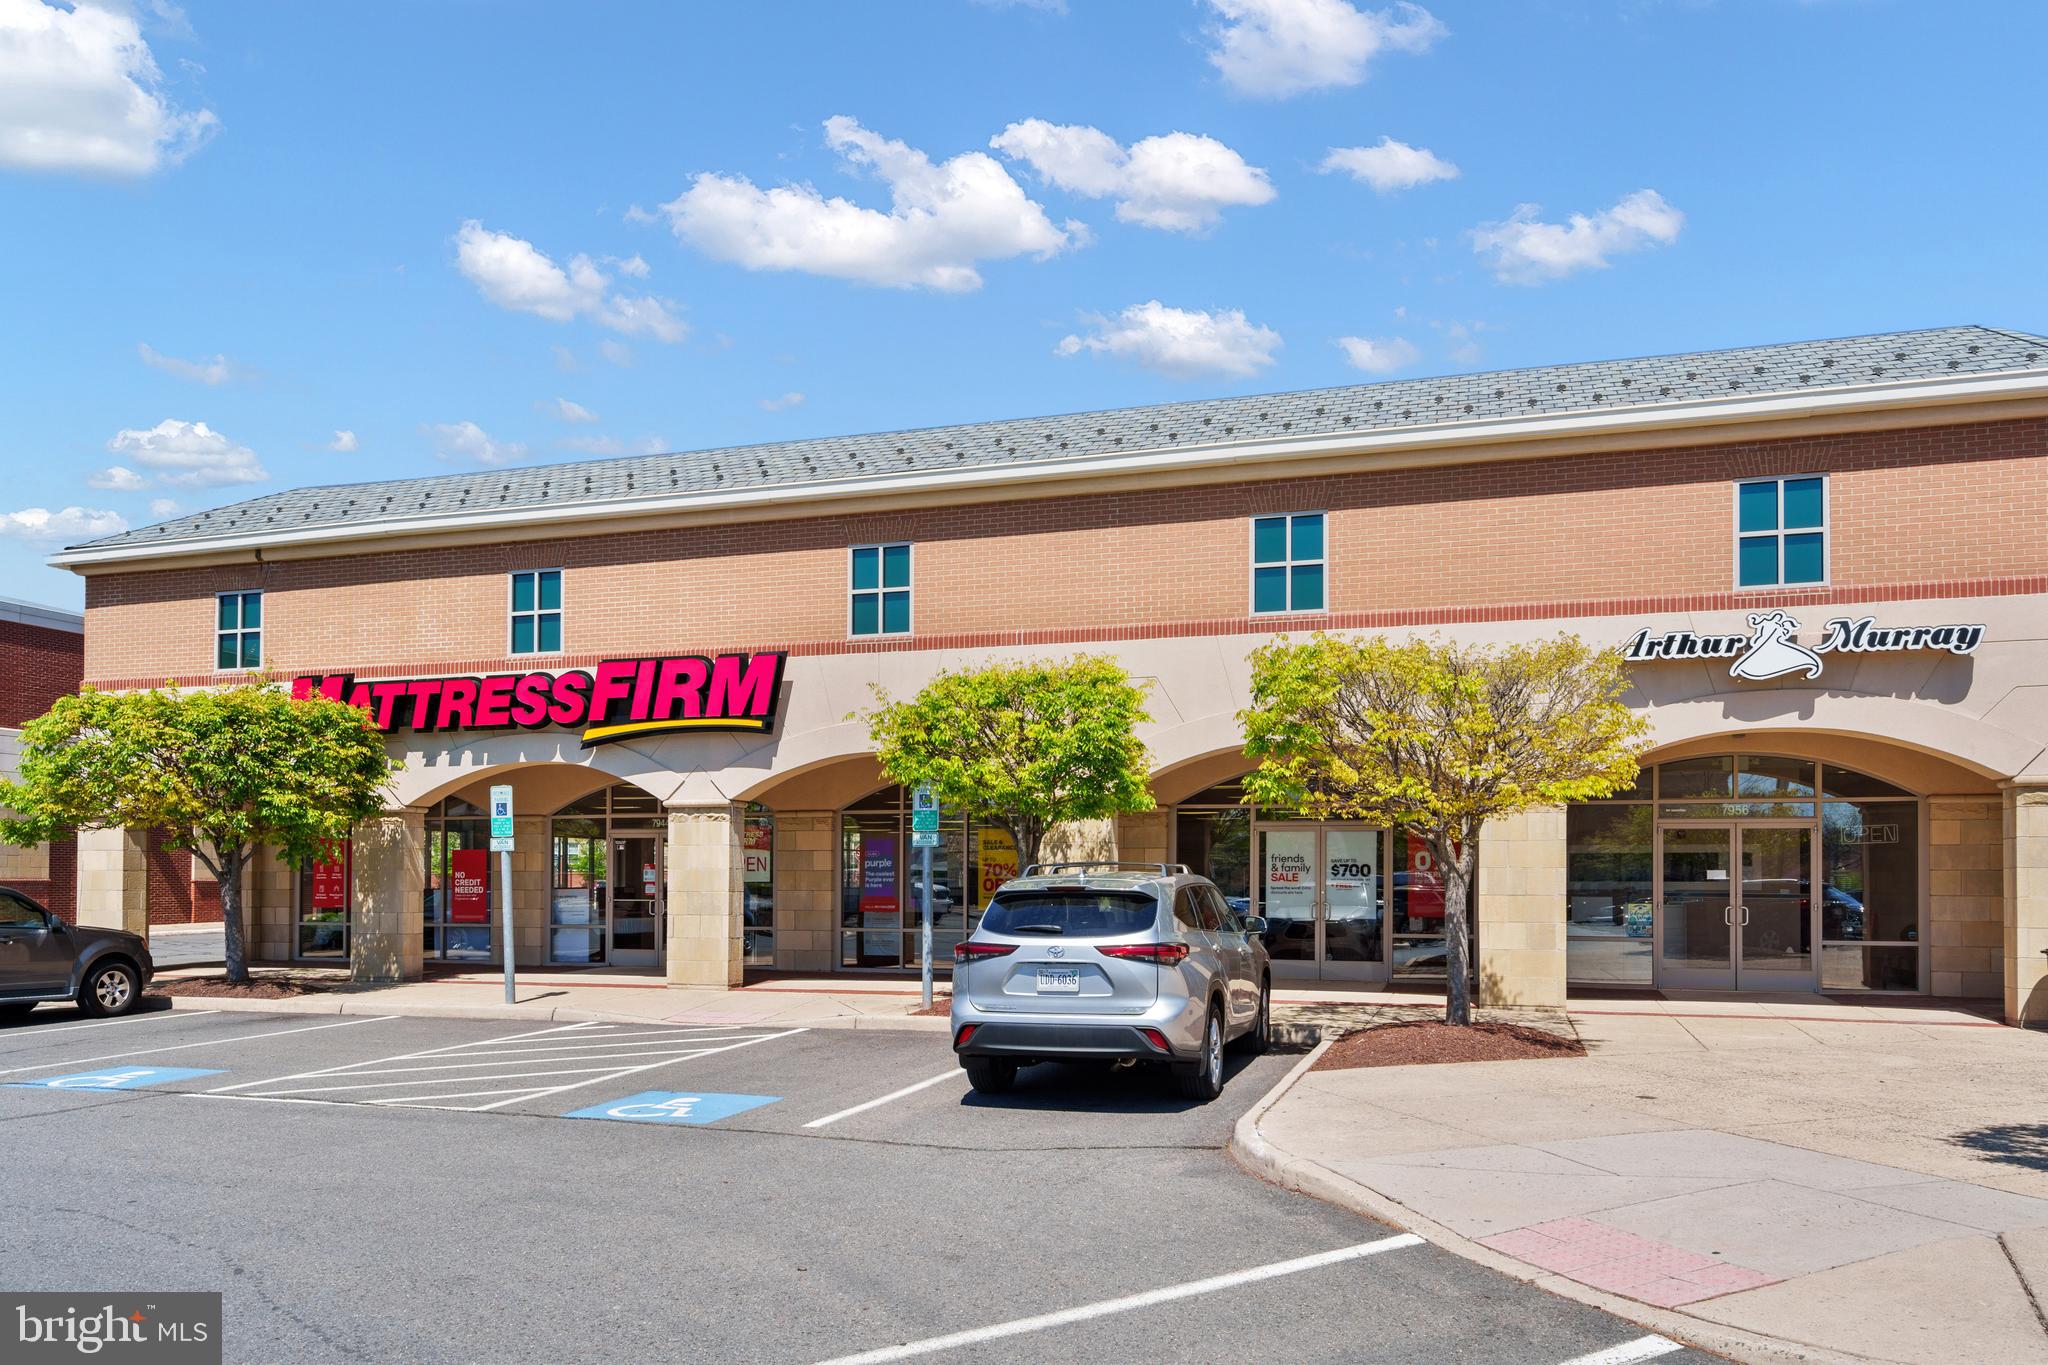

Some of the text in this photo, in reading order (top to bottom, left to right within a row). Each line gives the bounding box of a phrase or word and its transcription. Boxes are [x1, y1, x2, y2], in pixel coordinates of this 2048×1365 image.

[1622, 618, 1985, 658] Arthur Murray
[1723, 804, 1750, 815] 7956
[1843, 826, 1897, 843] OPEN
[1271, 853, 1305, 863] friends
[865, 859, 892, 869] purple
[1271, 863, 1311, 875] & family
[454, 871, 466, 879] NO
[983, 863, 1017, 877] 70%
[1331, 863, 1371, 877] $700
[1271, 873, 1299, 882] SALE
[454, 886, 484, 894] NEEDED
[983, 878, 1005, 892] OF
